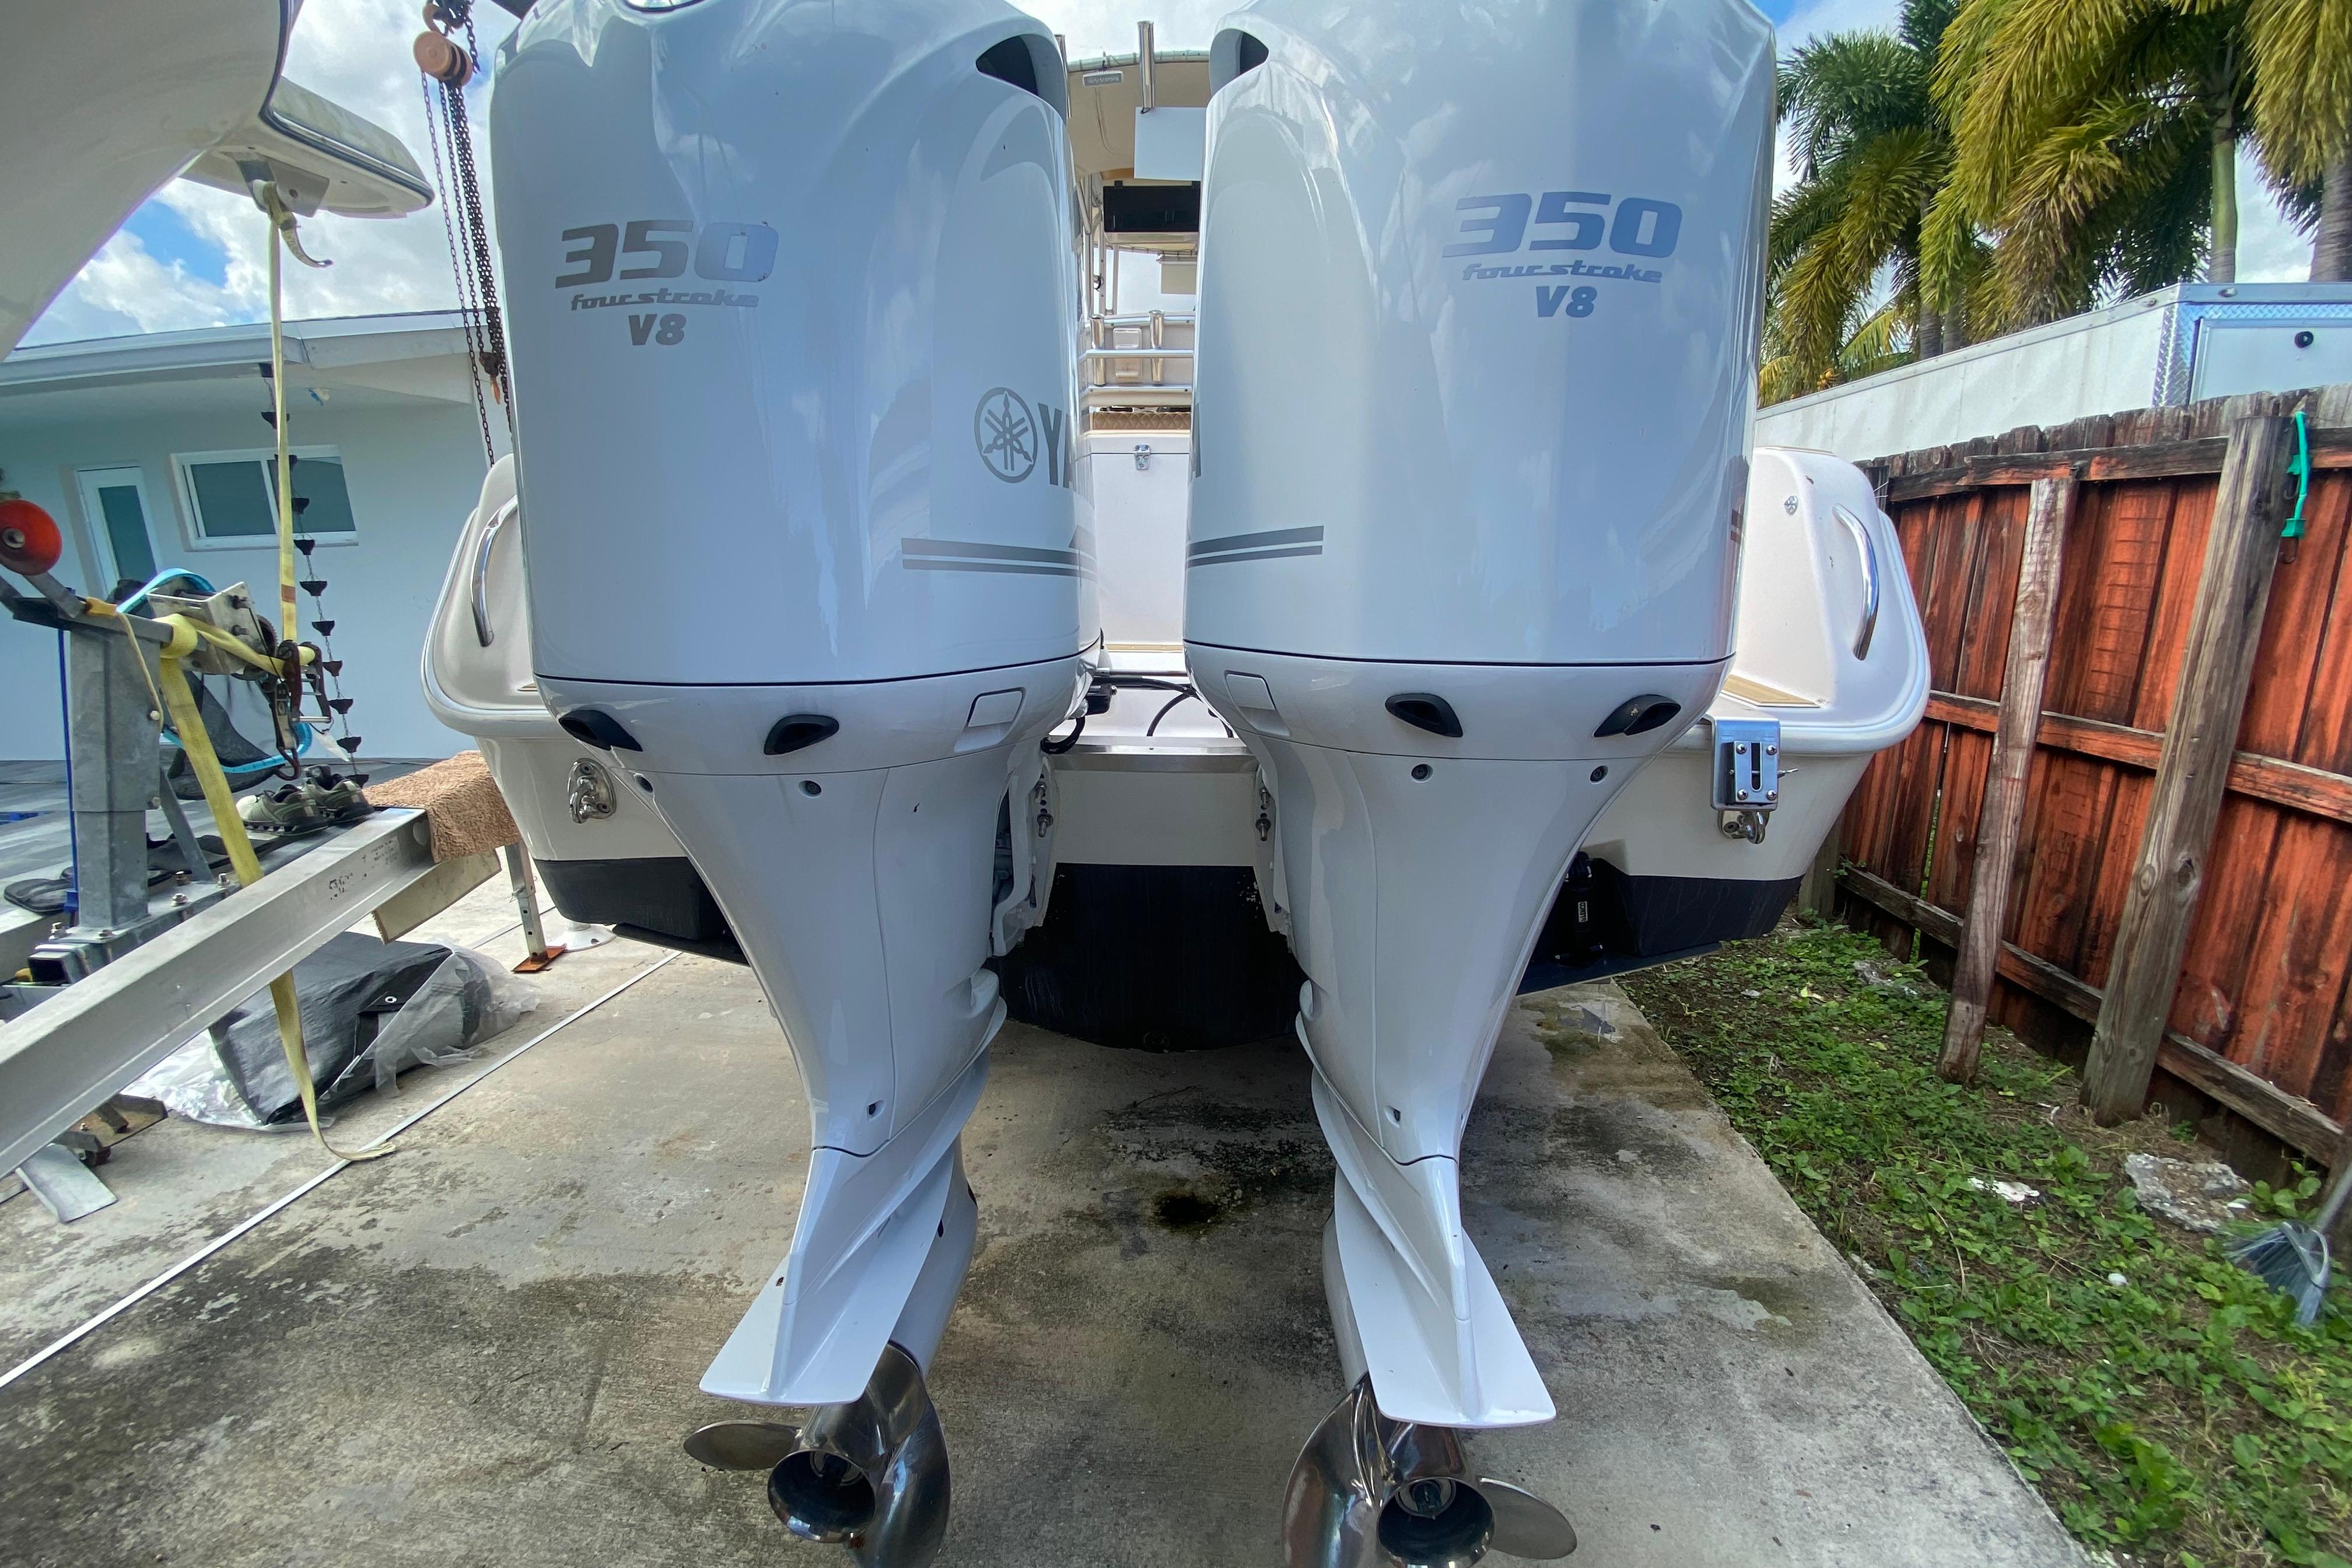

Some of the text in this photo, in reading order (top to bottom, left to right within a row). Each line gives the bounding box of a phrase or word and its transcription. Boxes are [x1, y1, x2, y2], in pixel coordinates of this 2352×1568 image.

[1441, 191, 1682, 258] 350
[555, 220, 779, 289] 350
[1536, 285, 1597, 318] V8
[628, 314, 687, 346] V8
